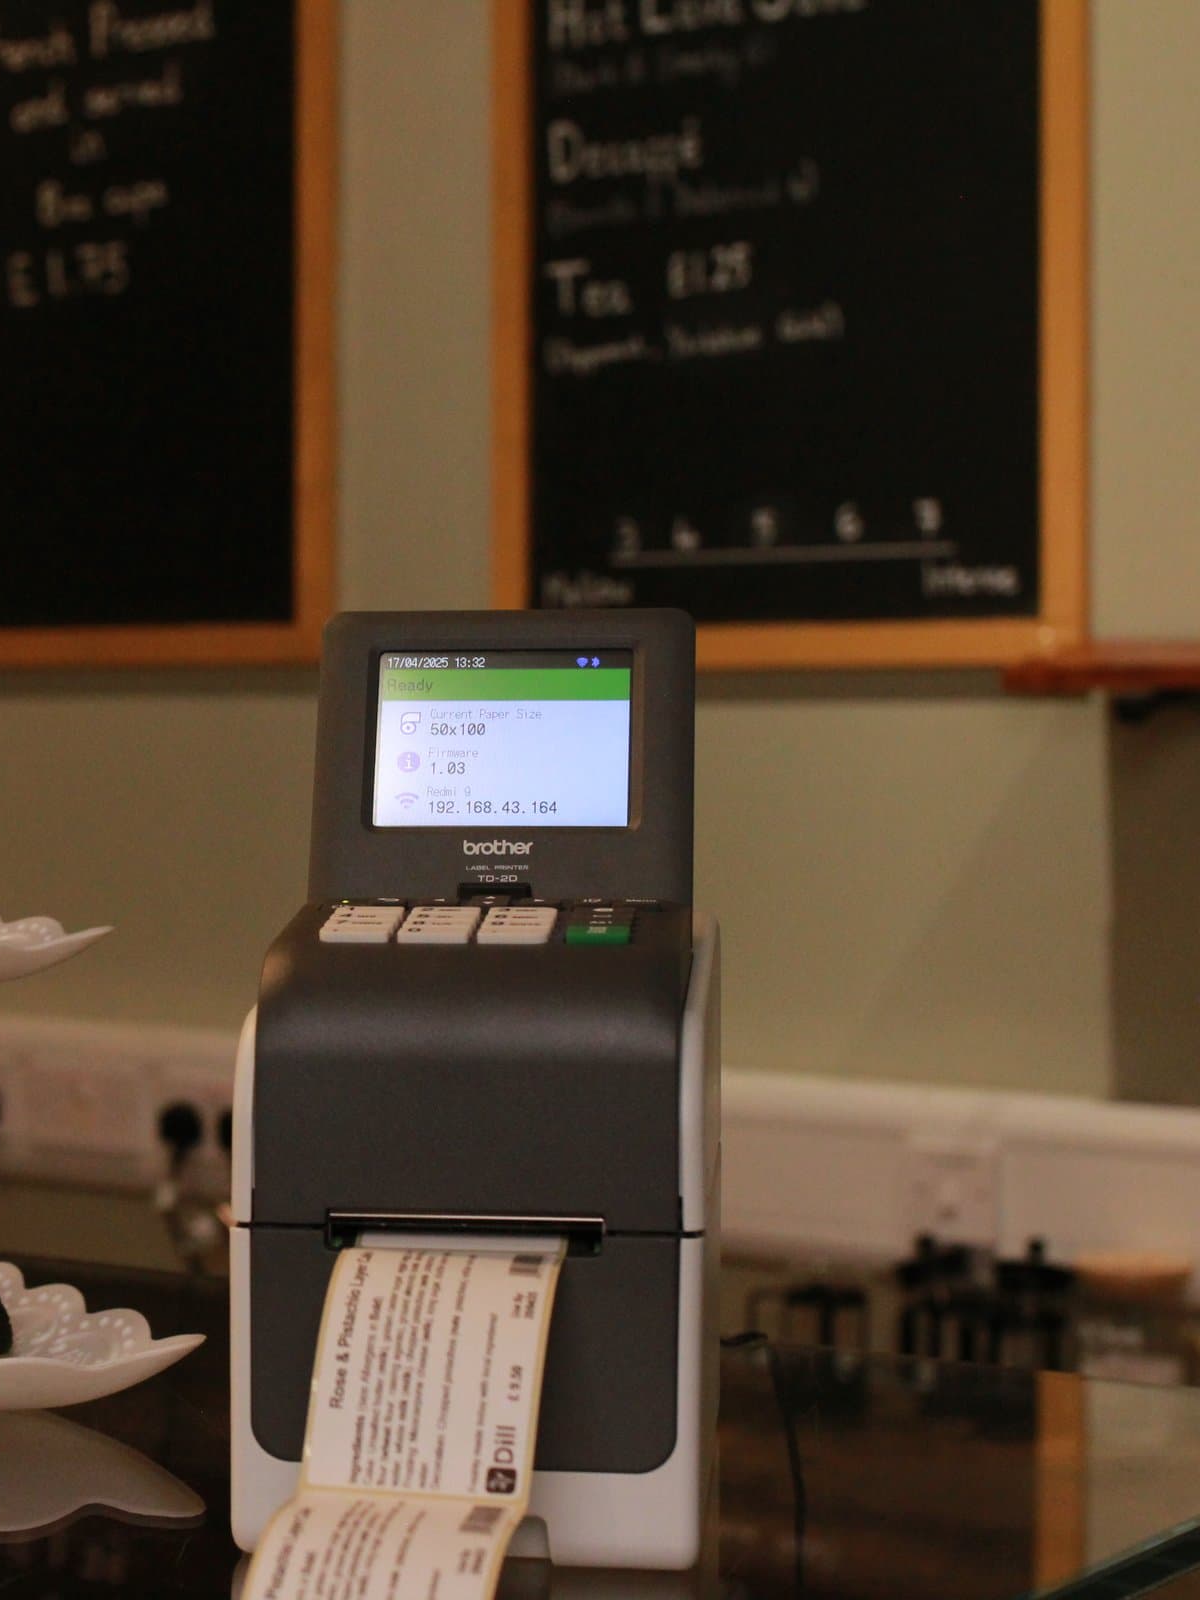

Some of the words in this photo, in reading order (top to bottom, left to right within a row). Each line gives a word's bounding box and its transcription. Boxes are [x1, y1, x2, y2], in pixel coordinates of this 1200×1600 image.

[543, 257, 633, 317] Tea
[387, 656, 449, 669] 17/04/2025
[455, 656, 486, 669] 13:32
[387, 678, 433, 694] Ready
[429, 708, 474, 721] Current
[479, 708, 512, 721] Paper
[515, 708, 543, 721] Size
[429, 722, 487, 737] 50x100
[427, 747, 480, 760] Firmware
[429, 762, 466, 776] 1.03
[426, 786, 458, 798] Redmi
[428, 800, 559, 815] 192.168.43.164
[462, 839, 534, 856] brother
[465, 864, 491, 872] LABEL
[494, 864, 530, 872] PRINTER
[336, 1289, 362, 1348] Pistachio
[335, 1351, 349, 1362] &
[327, 1367, 350, 1408] Rose
[490, 1424, 518, 1465] Dill
